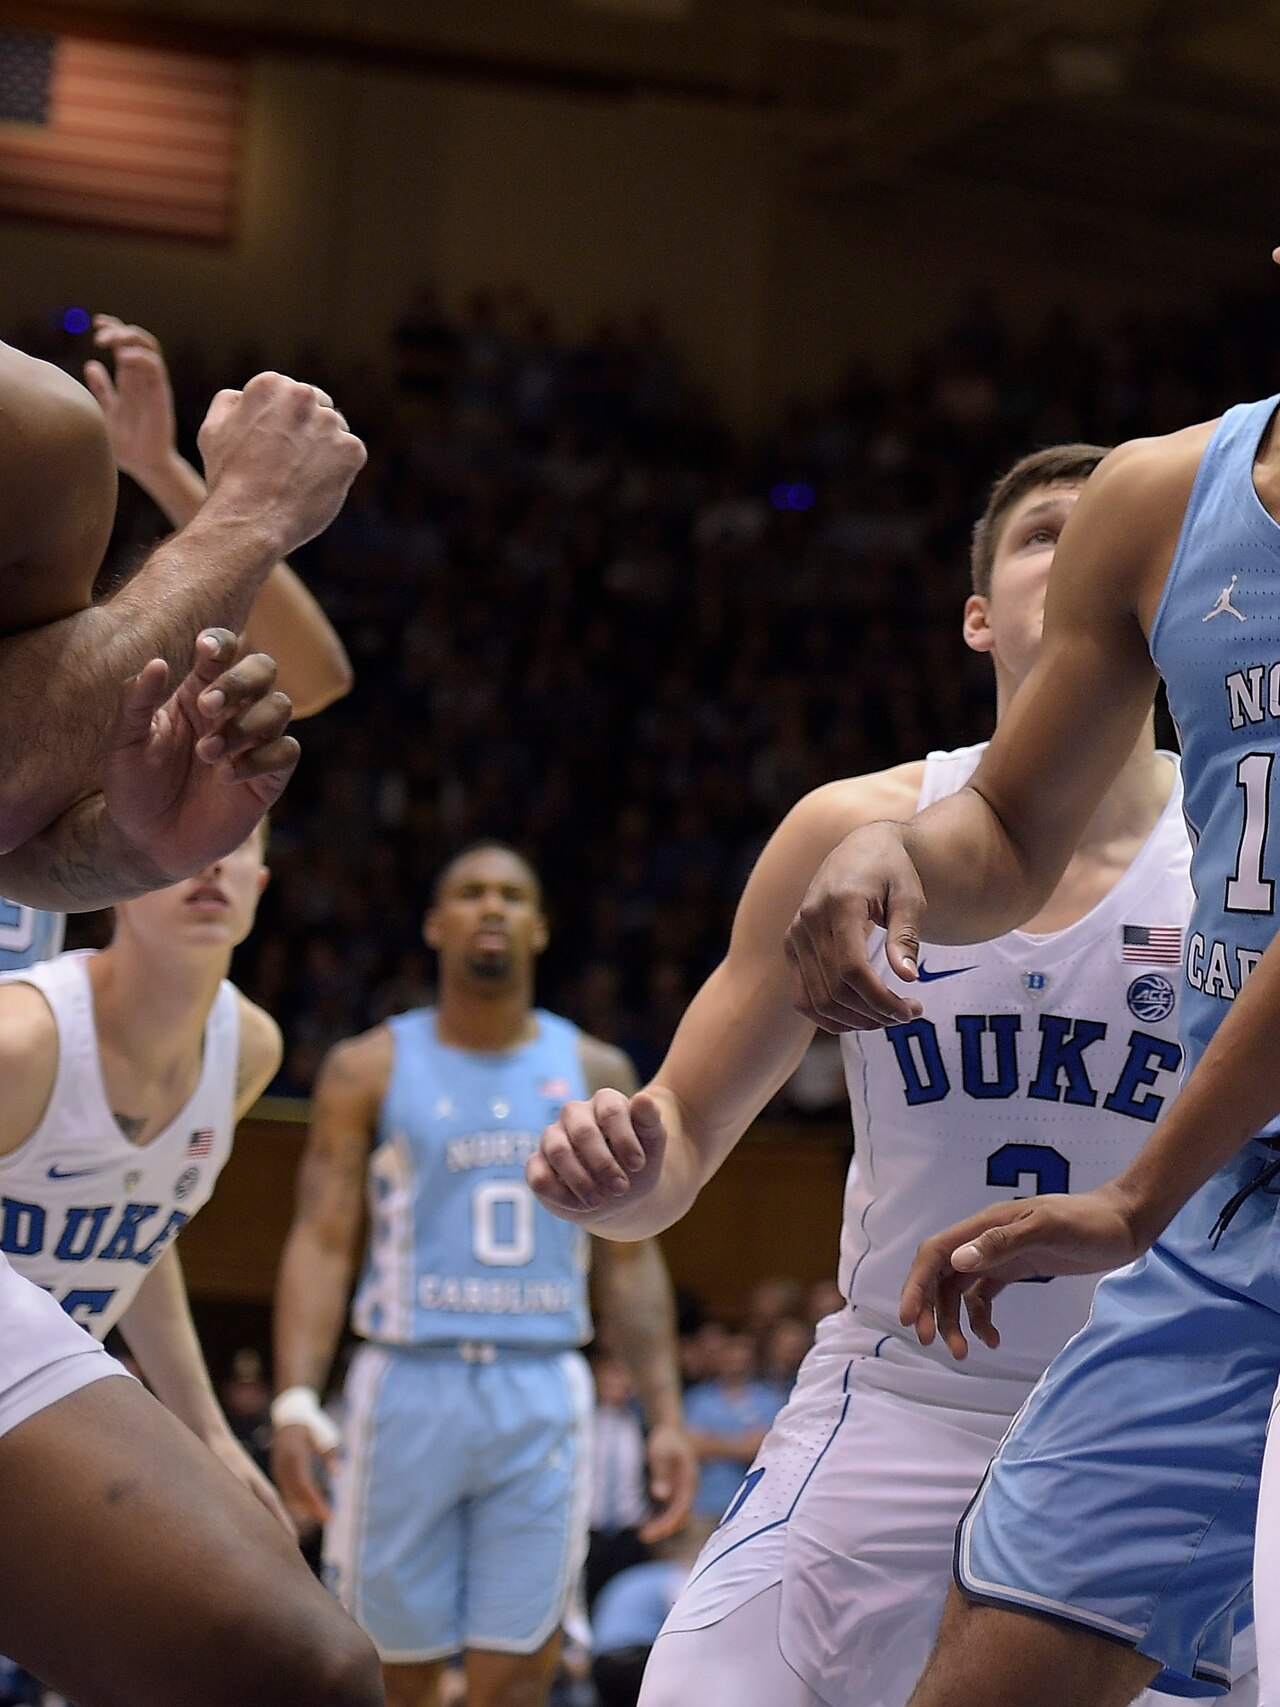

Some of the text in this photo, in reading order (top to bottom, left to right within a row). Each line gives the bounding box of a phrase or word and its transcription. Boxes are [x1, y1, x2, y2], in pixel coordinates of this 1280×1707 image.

[884, 1013, 1182, 1123] DUKE
[446, 1131, 540, 1174] NORT
[473, 1179, 534, 1267] 0
